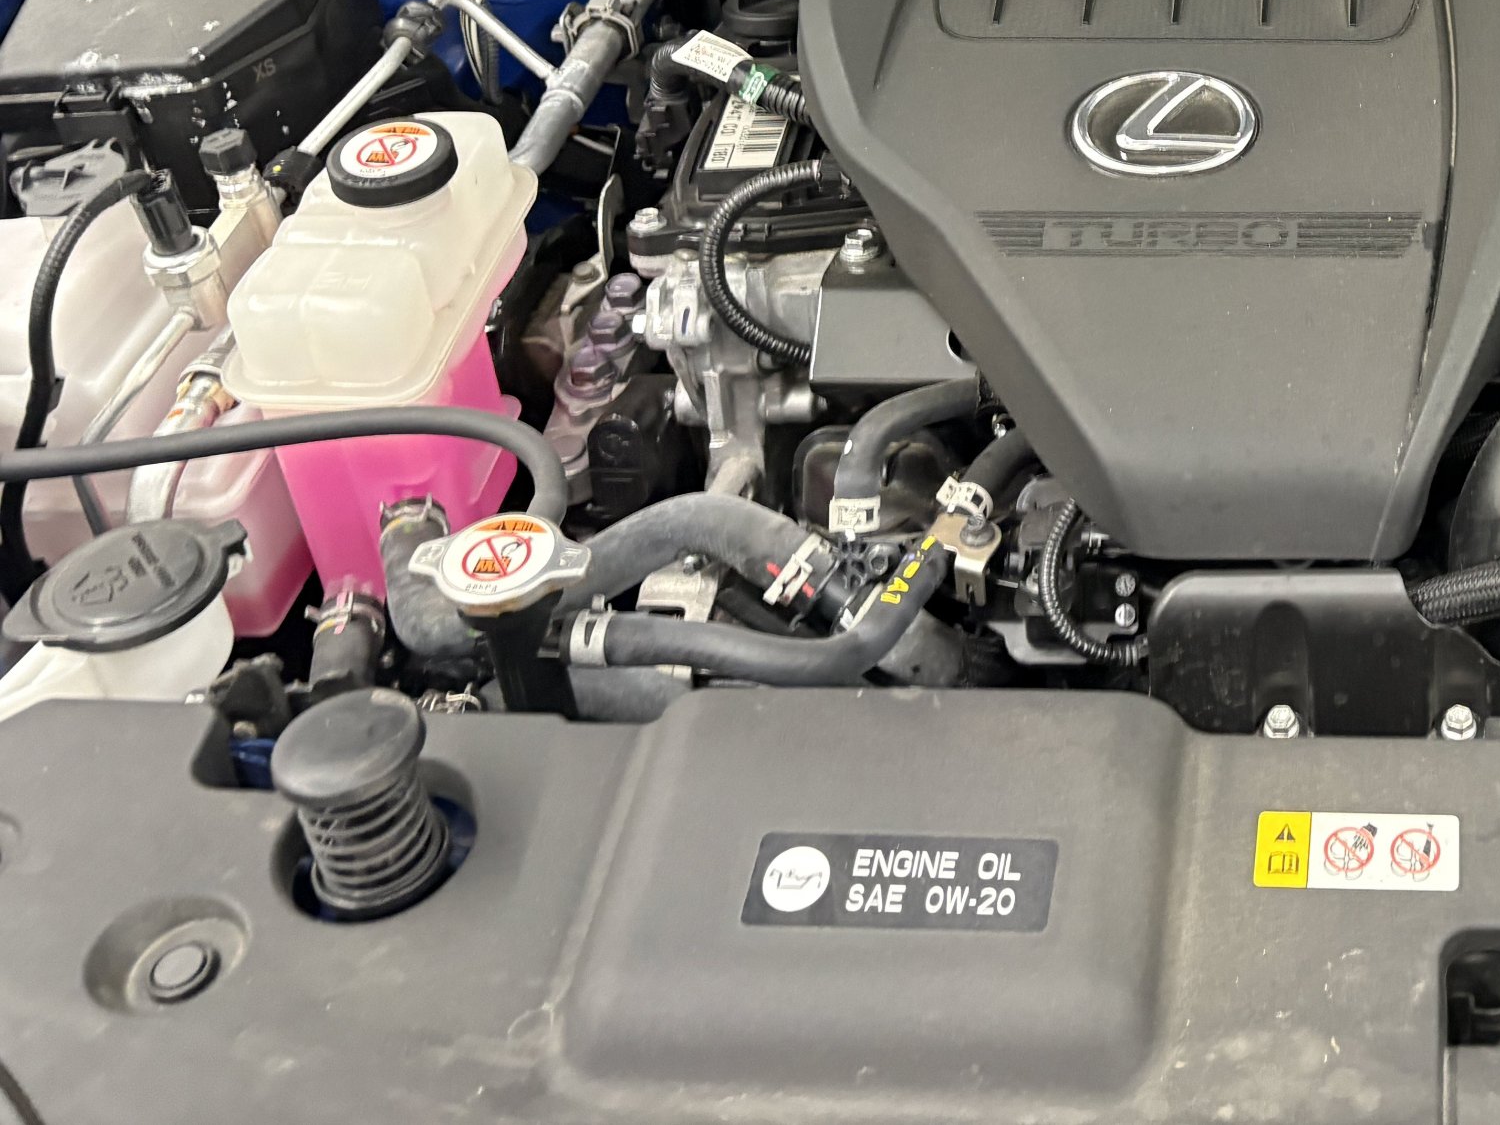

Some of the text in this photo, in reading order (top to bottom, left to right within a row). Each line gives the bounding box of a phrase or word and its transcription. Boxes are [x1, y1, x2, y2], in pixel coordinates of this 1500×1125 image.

[1046, 220, 1292, 249] TURBO
[852, 848, 1022, 882] ENGINE OIL
[845, 883, 1017, 916] SAE 0W-20
